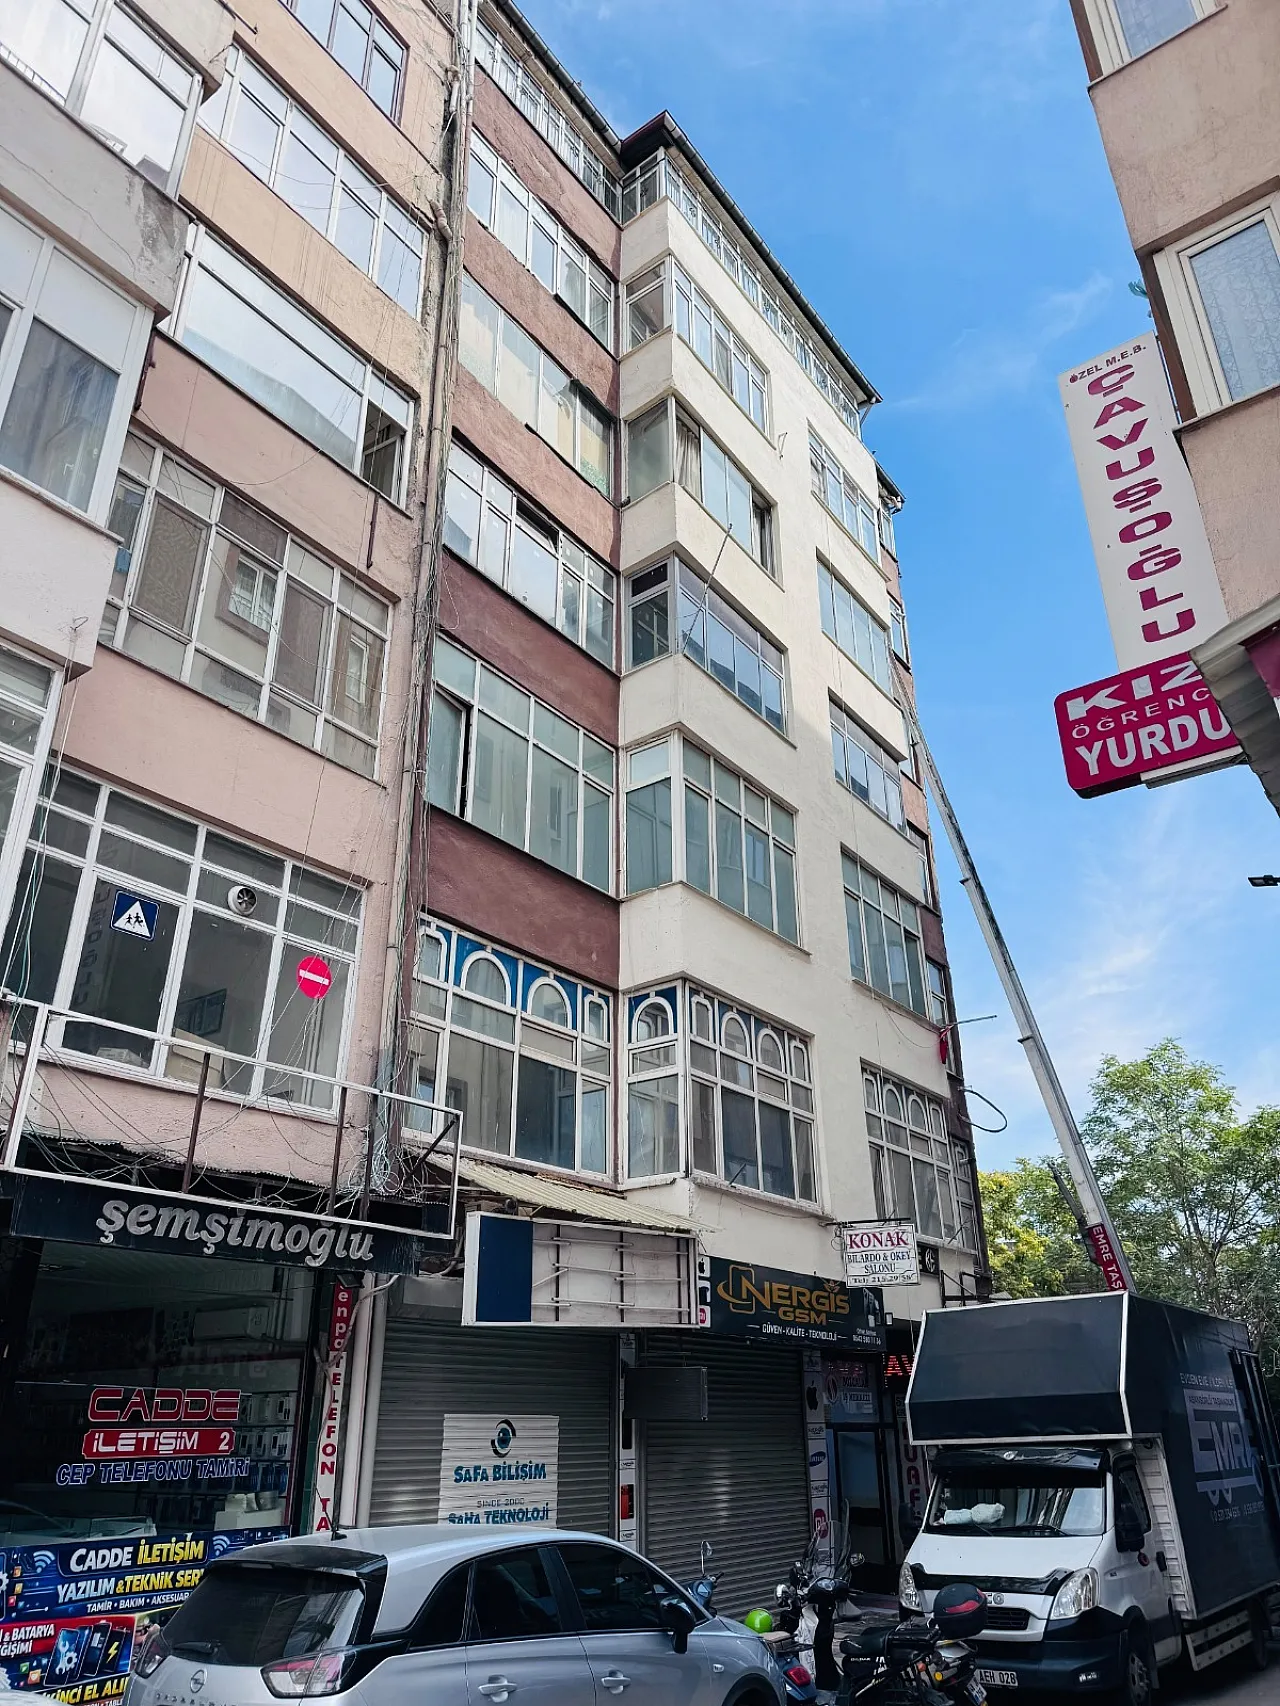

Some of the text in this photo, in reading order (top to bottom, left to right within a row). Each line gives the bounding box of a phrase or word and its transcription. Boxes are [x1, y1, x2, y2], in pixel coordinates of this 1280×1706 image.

[1069, 344, 1146, 383] ÖZEL M.E.B.
[1087, 364, 1196, 643] ÇAVUŞOĞLU
[1066, 661, 1203, 721] KIZ
[1071, 688, 1209, 739] ÖĞRENC
[1075, 706, 1232, 776] YURDU
[96, 1199, 375, 1268] Şemşimoğlu
[848, 1231, 910, 1249] KONAK
[1092, 1226, 1113, 1262] EMRE
[890, 1250, 911, 1260] OKEY
[864, 1263, 896, 1274] SALONU
[333, 1285, 349, 1350] enpa
[778, 1307, 827, 1326] GSM
[87, 1387, 242, 1422] CADDE
[218, 1431, 230, 1450] 2
[55, 1462, 96, 1485] CEP
[100, 1459, 192, 1484] TELEFONU
[453, 1460, 547, 1484] SAFA BİLİŞİM
[484, 1502, 549, 1525] TEKNOLOJİ
[70, 1538, 205, 1573] CADDE İLETİŞİM
[57, 1577, 116, 1604] YAZILIM
[86, 1600, 113, 1613] TAMİR
[119, 1597, 145, 1609] BAKIM
[11, 1624, 55, 1642] BATARYA
[0, 1639, 33, 1658] ĞİŞİMİ
[979, 1670, 1017, 1685] AEH 028
[83, 1683, 100, 1701] EL
